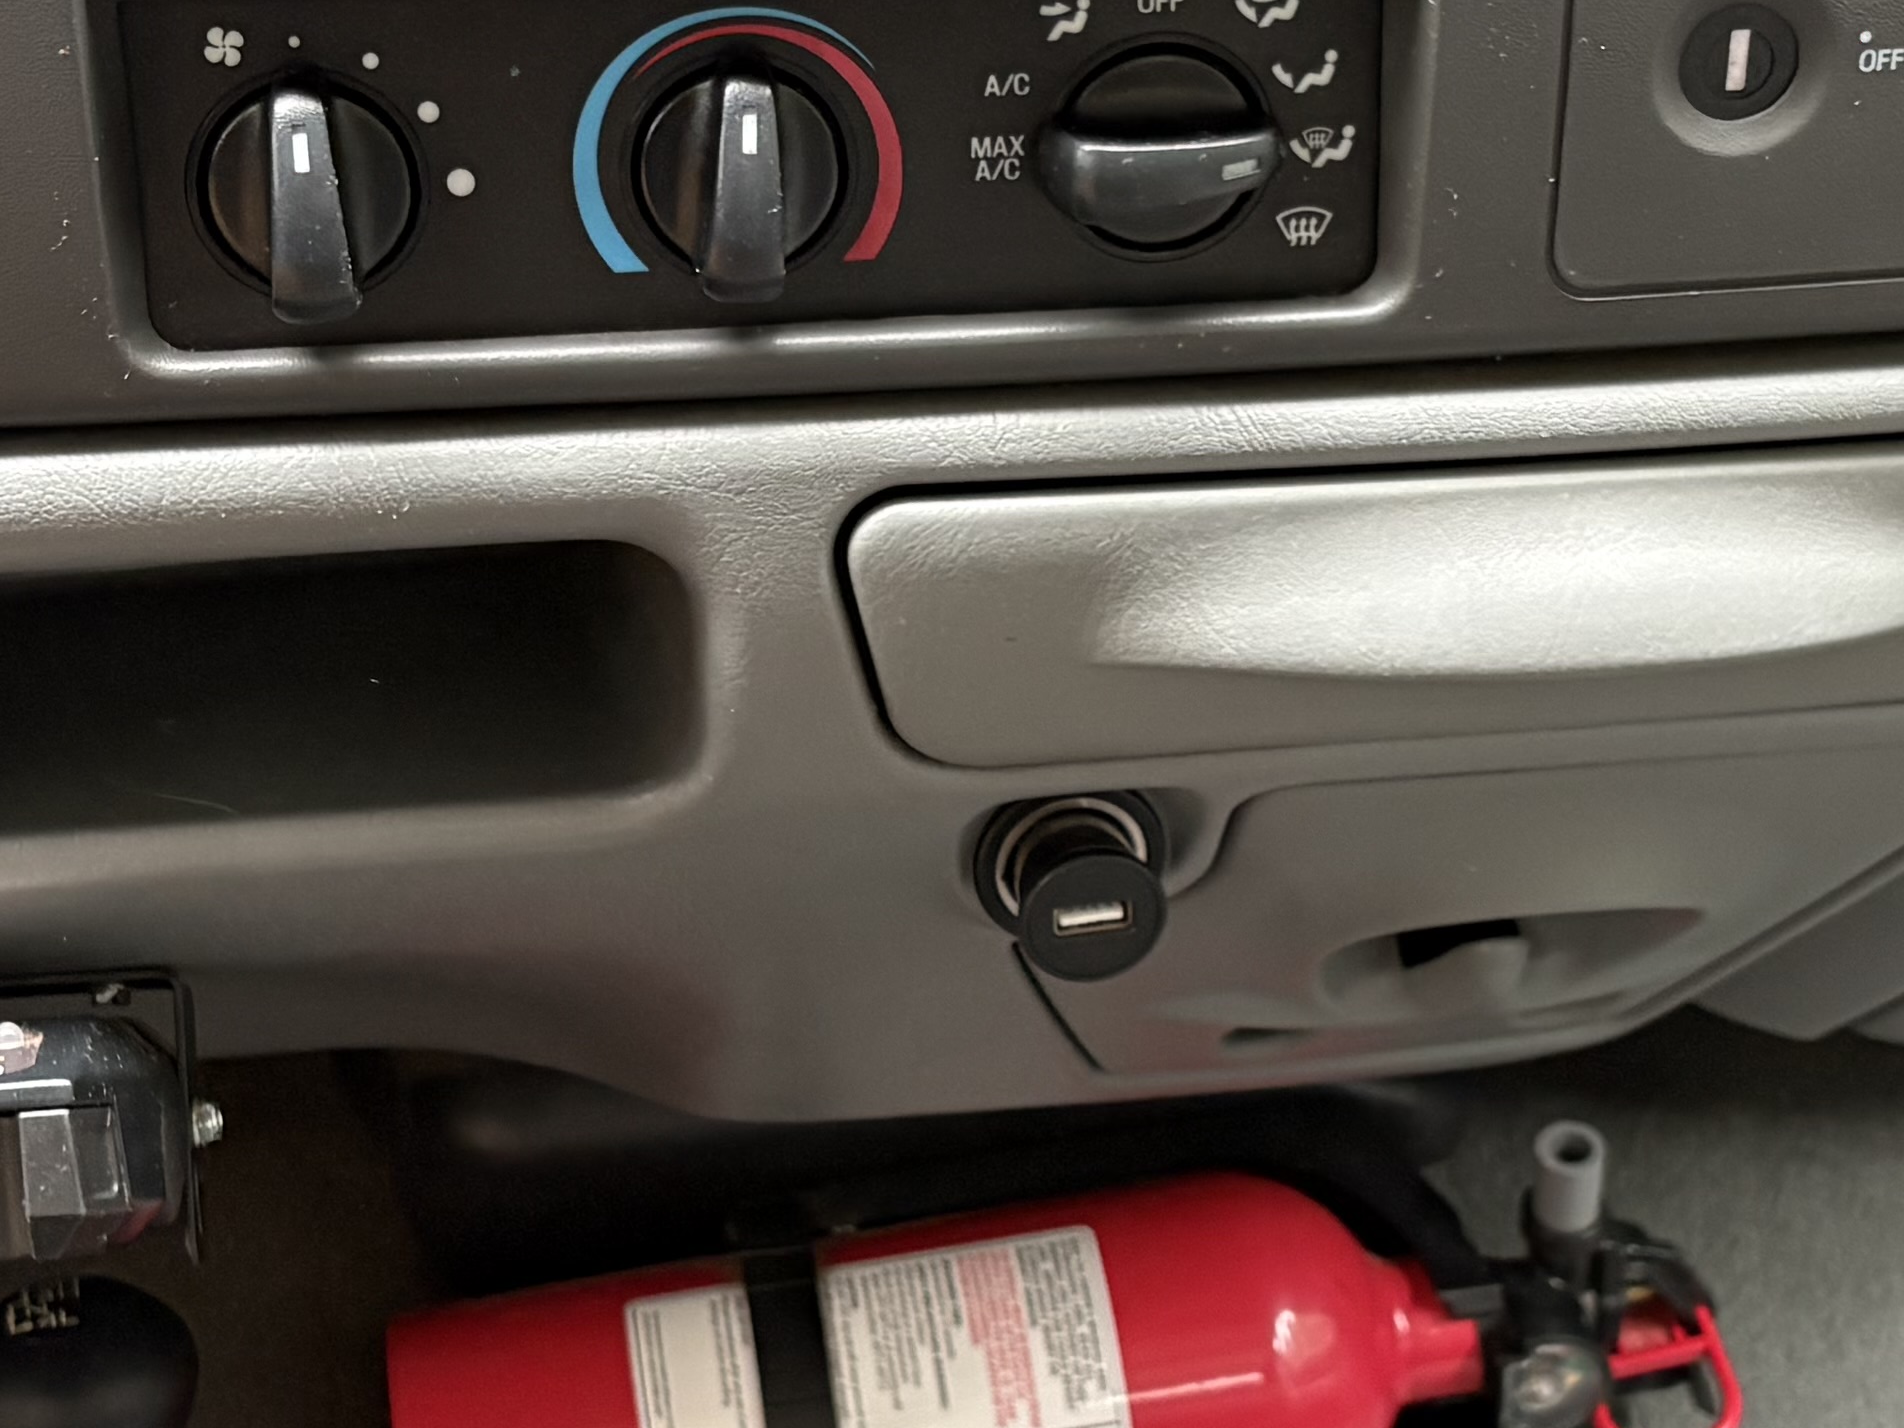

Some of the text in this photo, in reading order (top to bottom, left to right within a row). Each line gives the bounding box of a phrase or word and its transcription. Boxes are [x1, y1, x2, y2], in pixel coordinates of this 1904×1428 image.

[984, 72, 1030, 97] A/C
[970, 135, 1025, 157] MAX
[974, 159, 1021, 182] A/C
